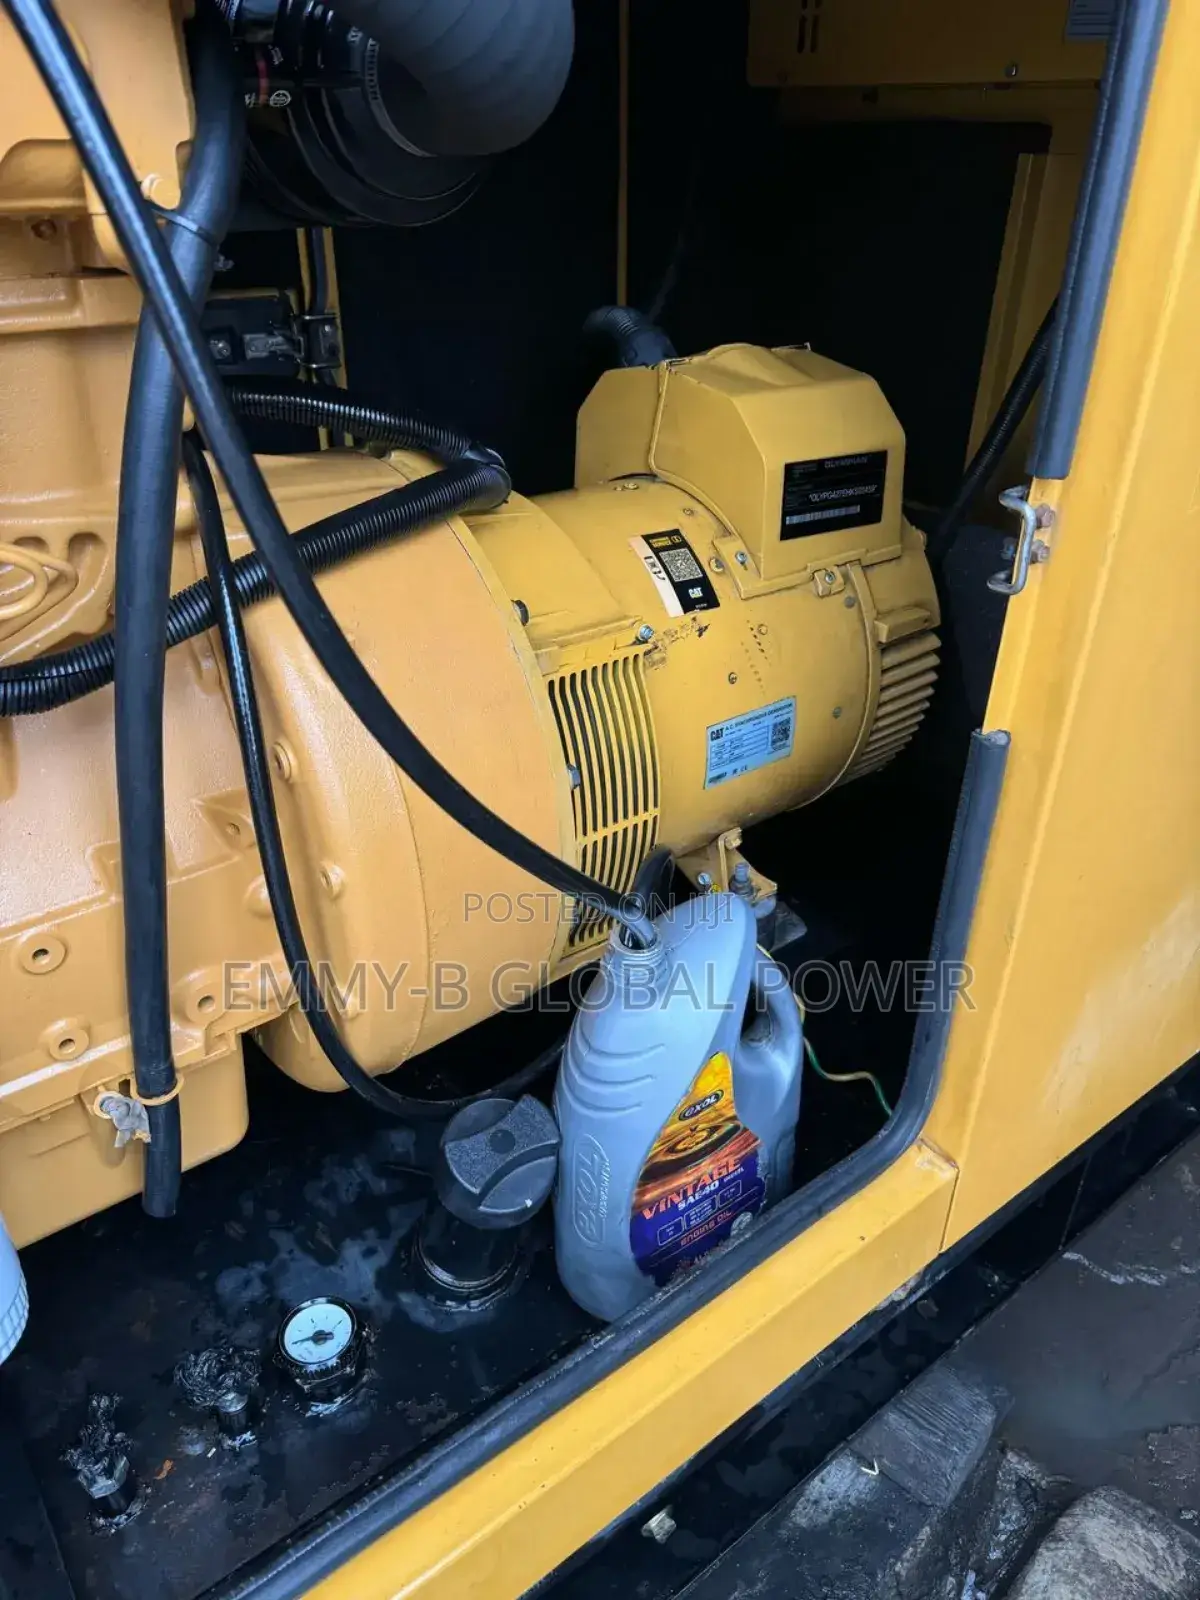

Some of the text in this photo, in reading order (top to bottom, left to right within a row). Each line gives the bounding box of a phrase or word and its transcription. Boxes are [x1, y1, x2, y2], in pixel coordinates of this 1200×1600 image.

[688, 587, 703, 599] CAT
[710, 727, 724, 742] CAT
[642, 1159, 741, 1220] VINTAGE
[678, 1179, 720, 1211] SAE40
